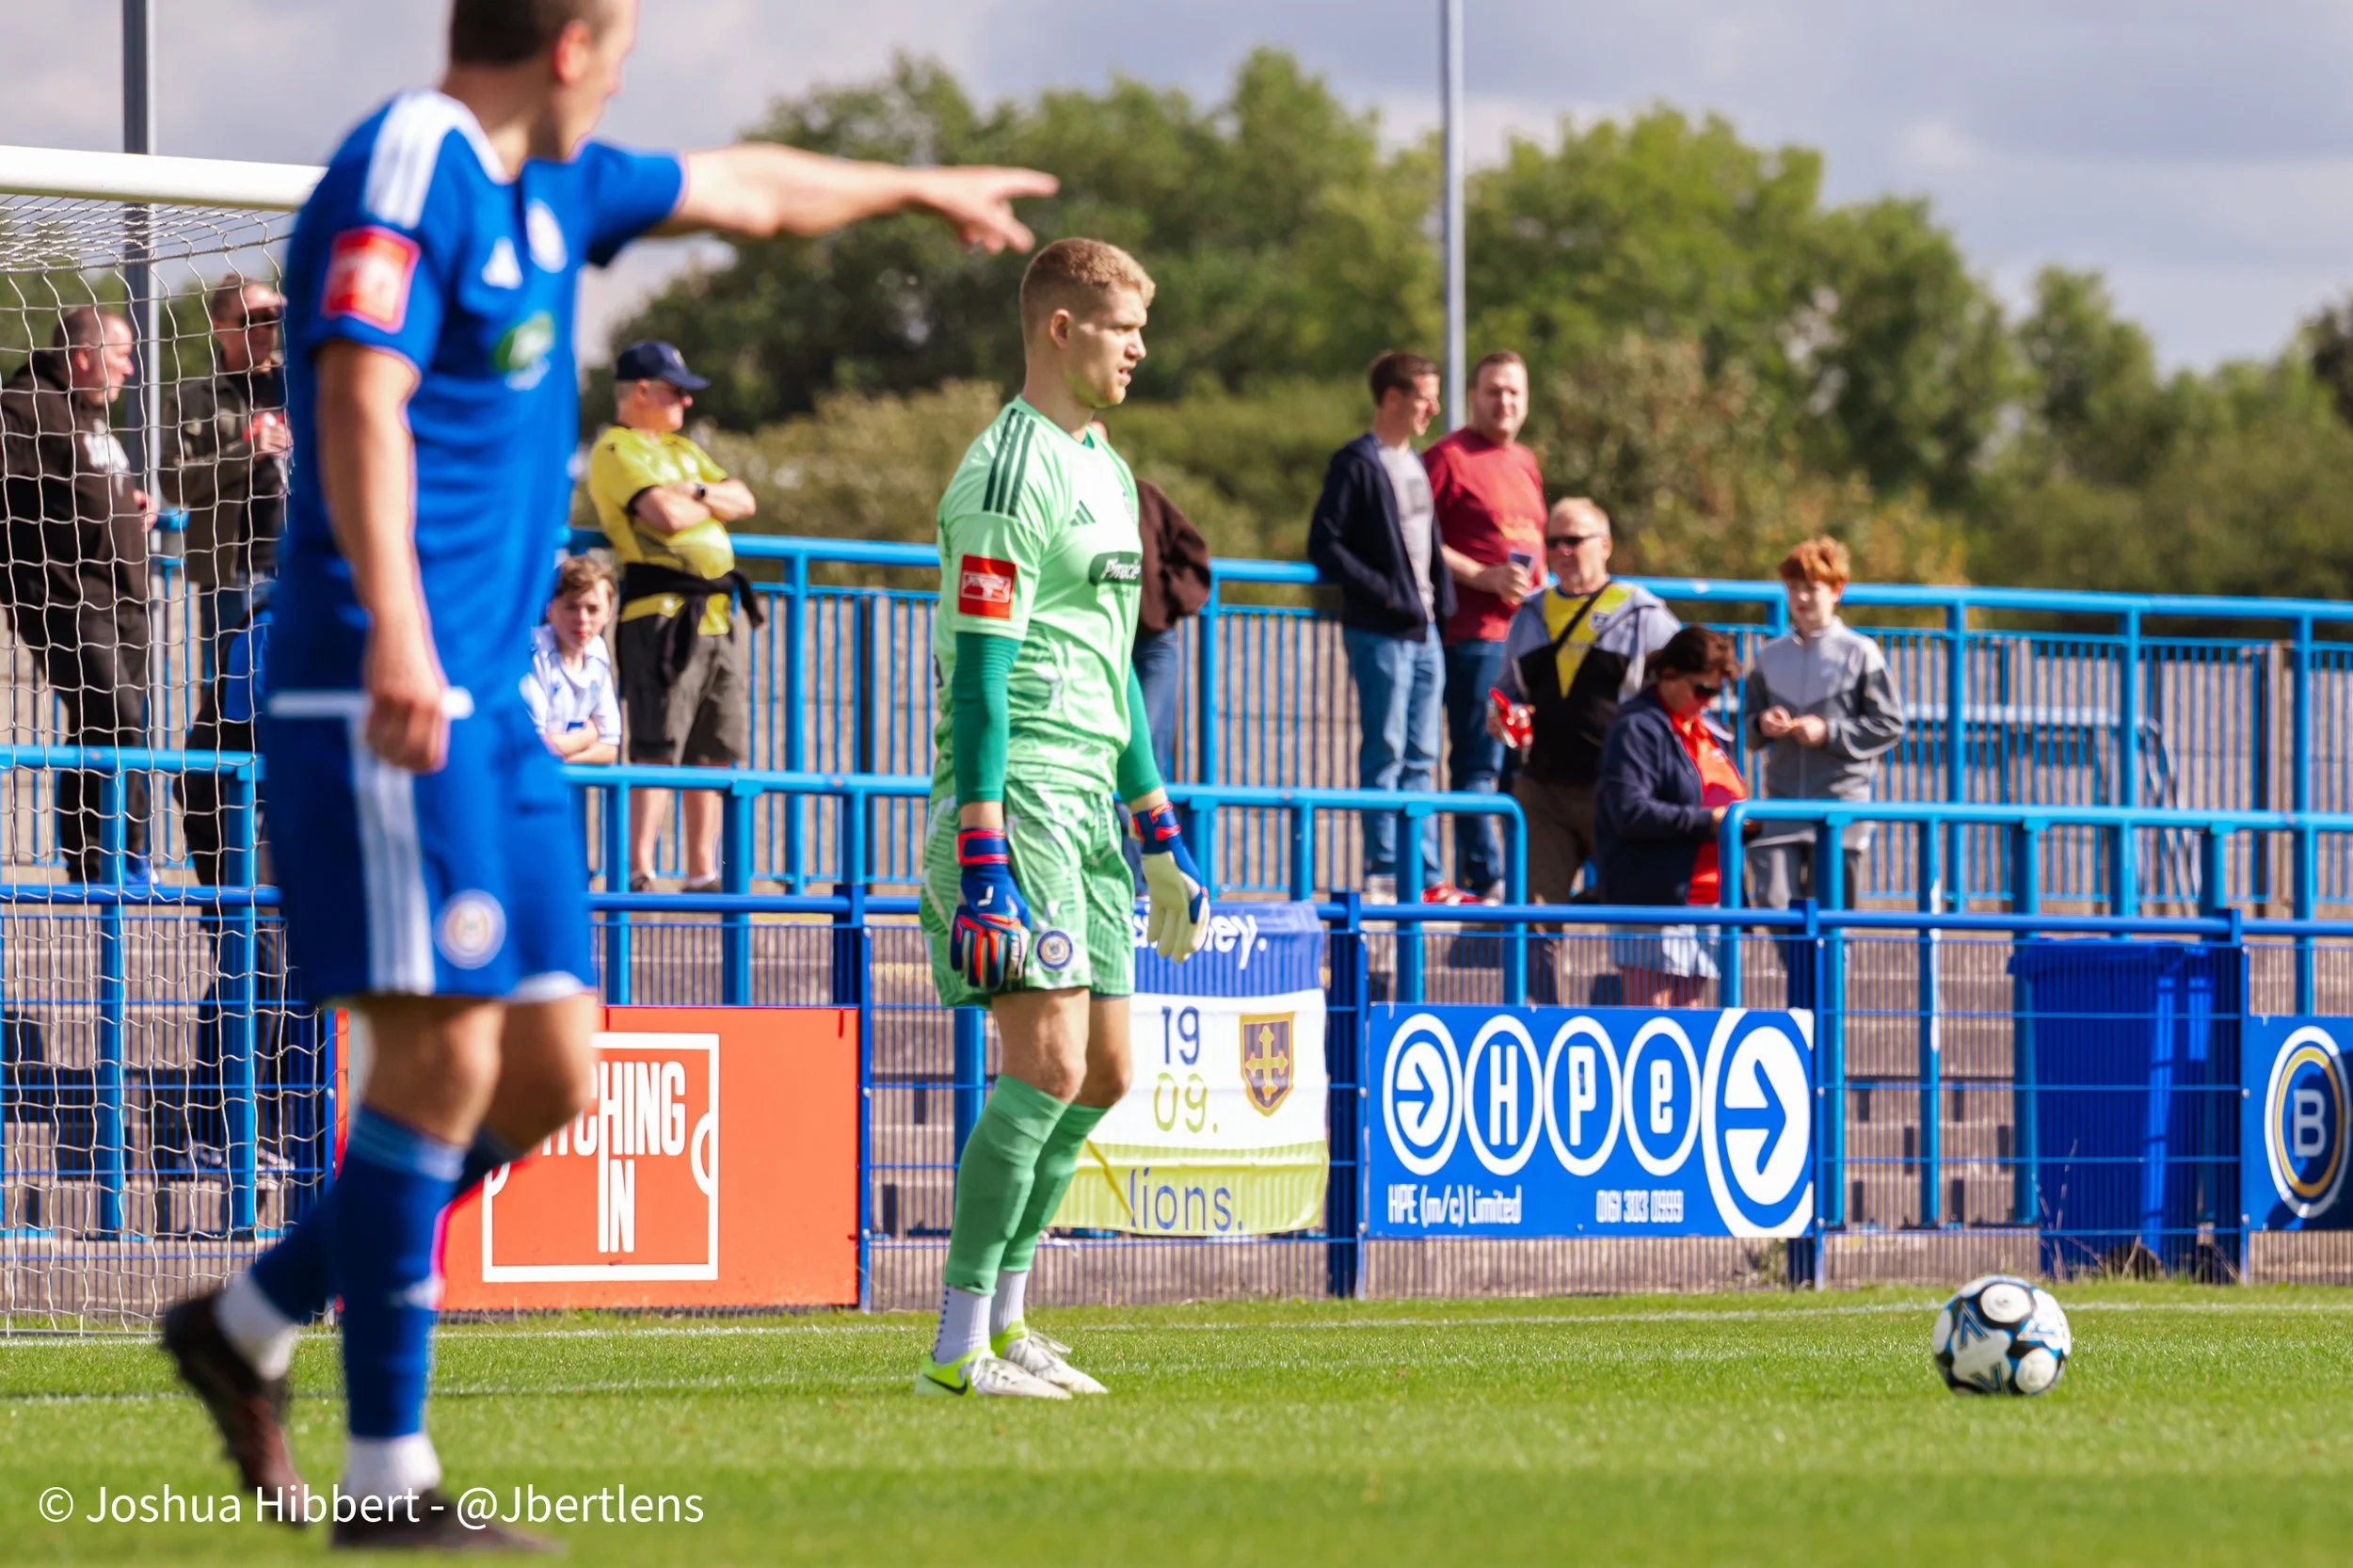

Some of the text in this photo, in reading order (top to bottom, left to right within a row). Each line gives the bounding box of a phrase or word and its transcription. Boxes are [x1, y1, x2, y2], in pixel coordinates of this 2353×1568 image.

[1161, 1005, 1200, 1065] 19
[2293, 1089, 2327, 1157] B
[598, 1159, 636, 1253] IN
[1130, 1167, 1243, 1231] lions.
[1388, 1183, 1522, 1228] HPE (m/c) Limited
